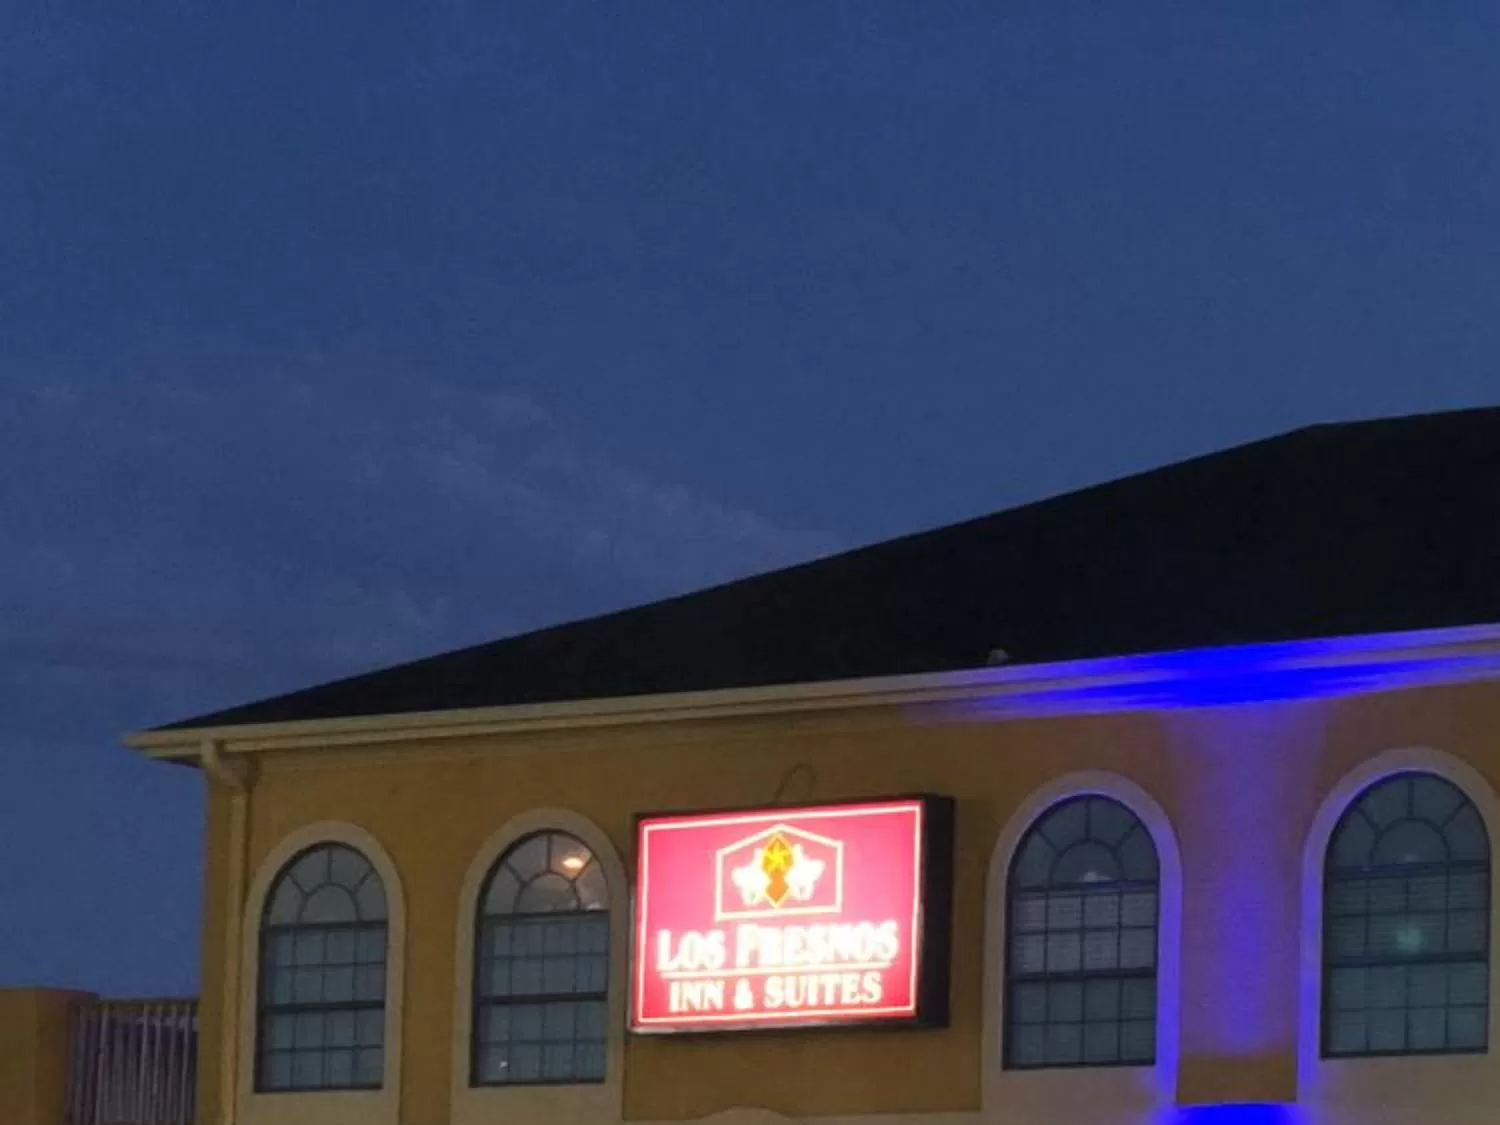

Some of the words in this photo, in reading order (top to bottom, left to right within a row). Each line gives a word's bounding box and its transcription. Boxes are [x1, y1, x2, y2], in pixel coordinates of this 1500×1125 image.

[657, 929, 725, 970] LOS
[669, 979, 723, 1012] INN
[734, 978, 753, 1009] &
[764, 971, 882, 1008] SUITES
